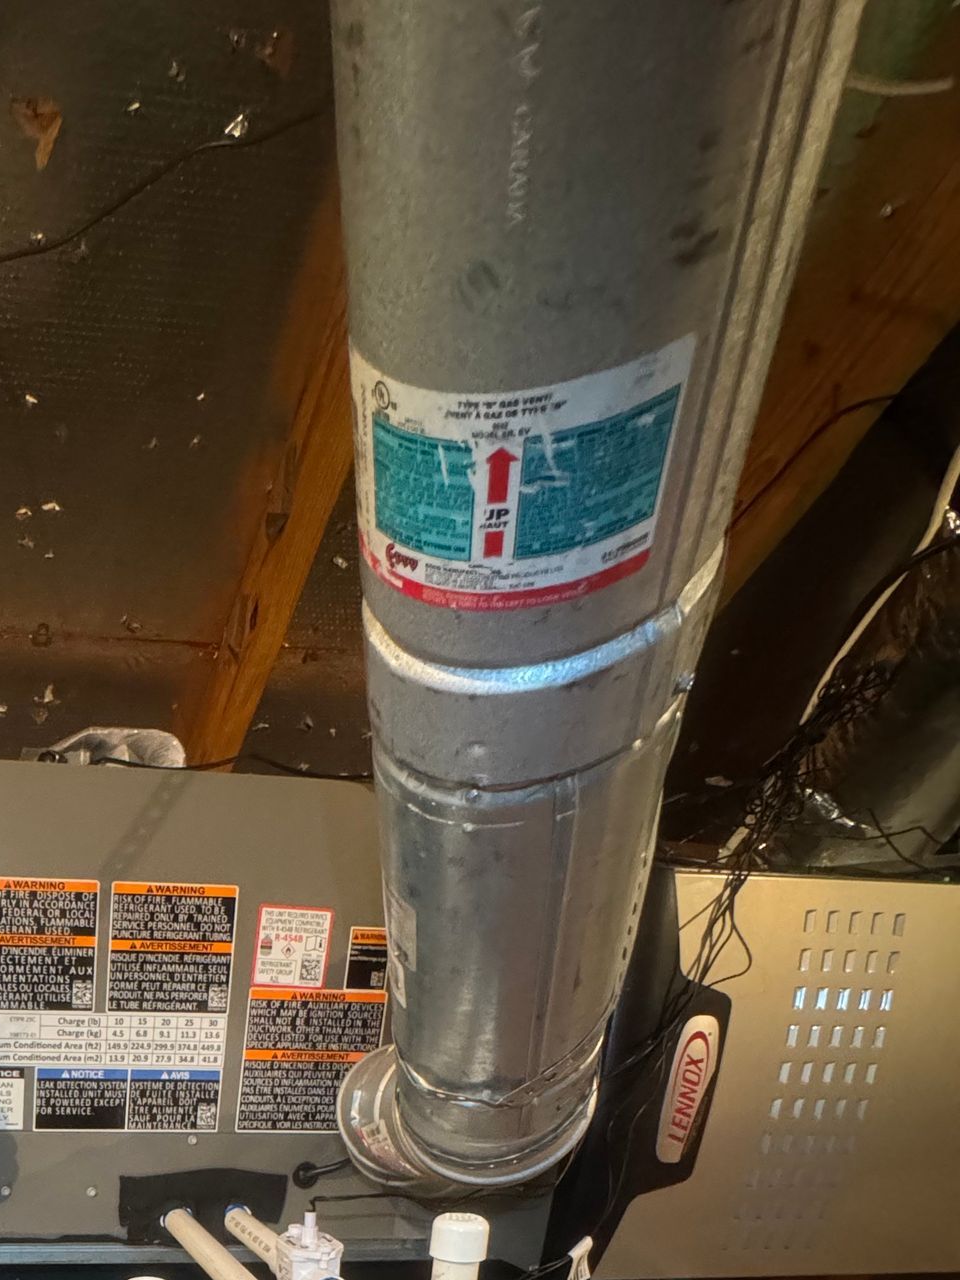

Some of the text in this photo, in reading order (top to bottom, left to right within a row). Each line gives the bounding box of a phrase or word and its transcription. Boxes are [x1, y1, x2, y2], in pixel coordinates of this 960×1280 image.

[13, 881, 65, 890] WARNING
[155, 886, 205, 895] WARNING
[37, 892, 75, 900] DISPOSE
[114, 894, 222, 906] RISK OF FLAMMABLE
[20, 900, 29, 908] IN
[33, 900, 95, 910] ACCORDANCE
[114, 903, 225, 915] REFRIGERANT TO BE
[2, 908, 43, 917] FEDERAL
[47, 909, 60, 917] OR
[66, 910, 94, 919] LOCAL
[113, 912, 228, 923] REPAIRED ONLY BY TRAINED
[41, 918, 94, 927] FLAMMABLE
[113, 921, 145, 929] SERVICE
[201, 923, 212, 931] DO
[0, 936, 76, 945] AVERTISSEMENT
[275, 934, 304, 942] R-454B
[140, 942, 214, 951] AVERTISSEMENT
[65, 956, 76, 965] ET
[69, 966, 93, 975] AUX
[208, 965, 227, 974] SEUL
[110, 971, 171, 981] UN PERSONNEL
[20, 983, 32, 992] OU
[142, 981, 207, 991] PEUT CE
[299, 992, 346, 1001] WARNING
[109, 1001, 139, 1009] LE TUBE
[251, 1000, 267, 1008] RISK
[307, 1002, 348, 1010] AUXILIARY
[351, 1003, 383, 1011] DEVICES
[58, 1017, 85, 1027] Charge
[88, 1017, 101, 1027] (lb)
[184, 1019, 194, 1027] 25
[310, 1018, 351, 1027] INSTALLED
[367, 1020, 380, 1028] THE
[57, 1029, 84, 1038] Charge
[87, 1029, 101, 1039] (kg)
[181, 1031, 196, 1039] 11.3
[296, 1026, 319, 1034] OTHER
[281, 1034, 305, 1042] LISTED
[14, 1041, 62, 1049] Conditioned
[85, 1042, 101, 1051] (ft2)
[154, 1043, 175, 1051] 299.9
[13, 1053, 62, 1061] Conditioned
[84, 1055, 102, 1063] (m2)
[281, 1052, 350, 1060] AVERTISSEMENT
[71, 1070, 104, 1079] NOTICE
[57, 1081, 97, 1089] DETECTION
[668, 1054, 704, 1144] LENNOX
